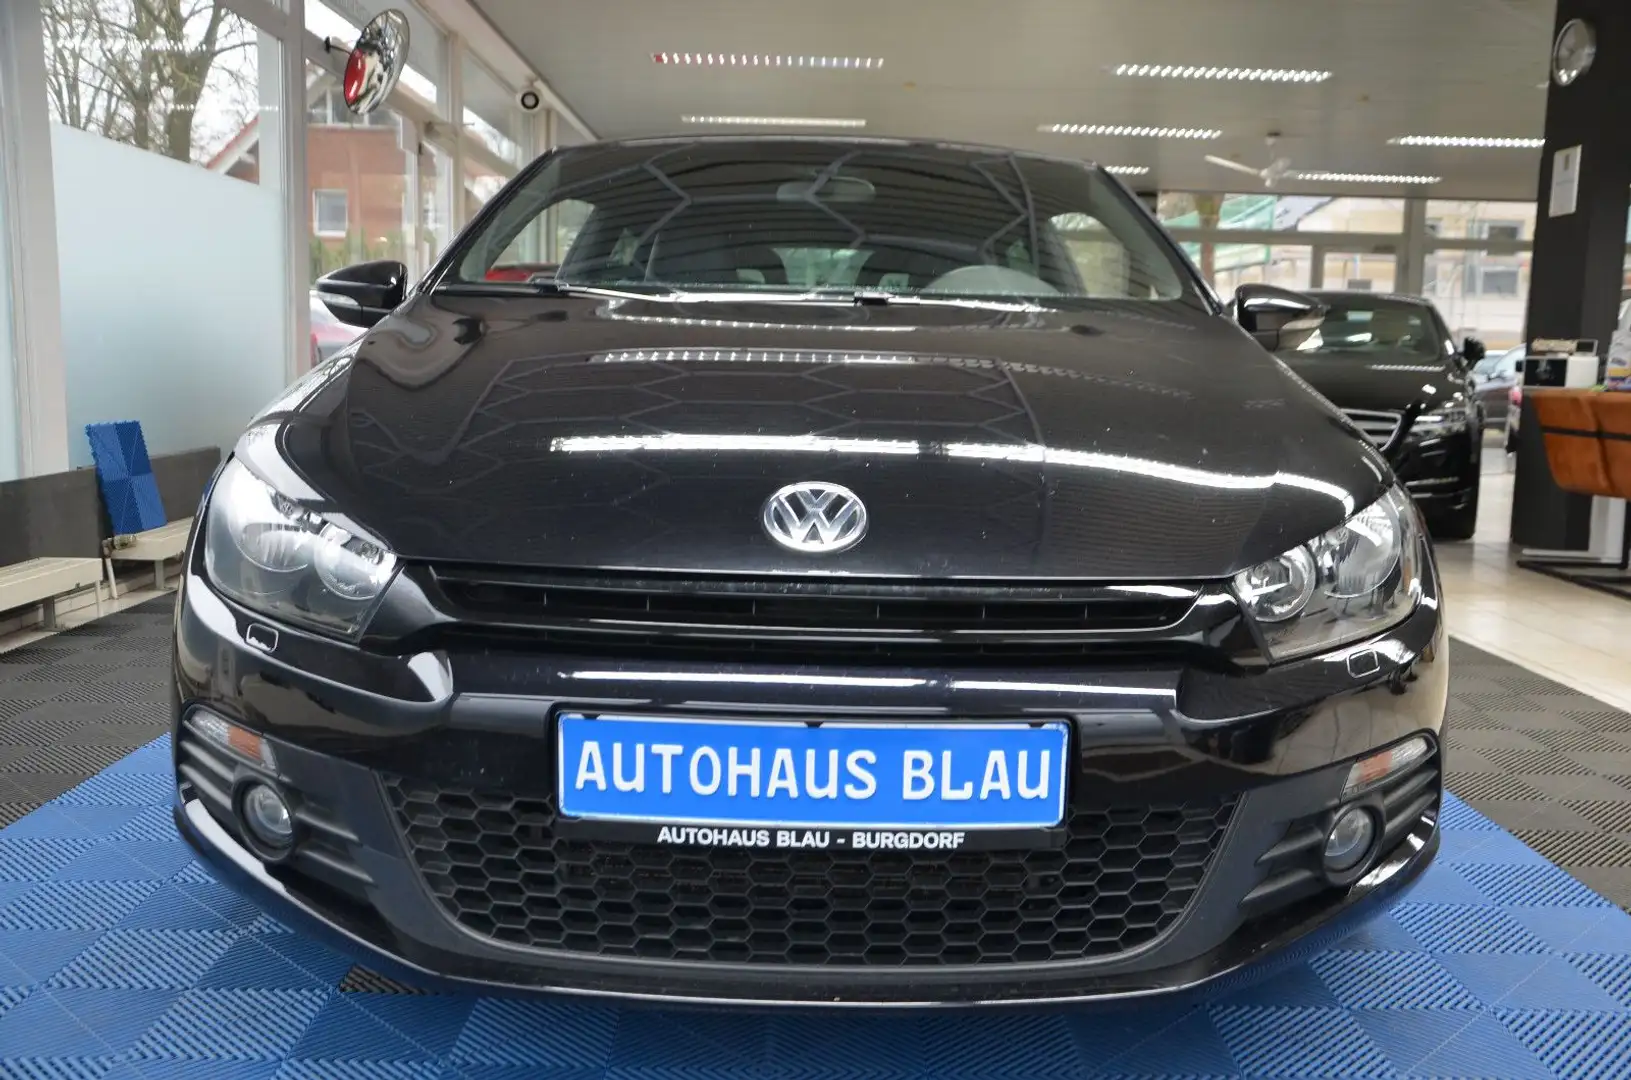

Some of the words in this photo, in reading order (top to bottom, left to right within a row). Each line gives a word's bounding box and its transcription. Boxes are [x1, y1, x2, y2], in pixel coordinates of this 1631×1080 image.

[766, 483, 866, 551] VW
[575, 740, 877, 799] AUTOHAUS
[902, 750, 1051, 801] BLAU
[657, 826, 770, 847] AUTOHAUS
[776, 829, 830, 848] BLAU
[852, 832, 966, 850] BURGDORF
